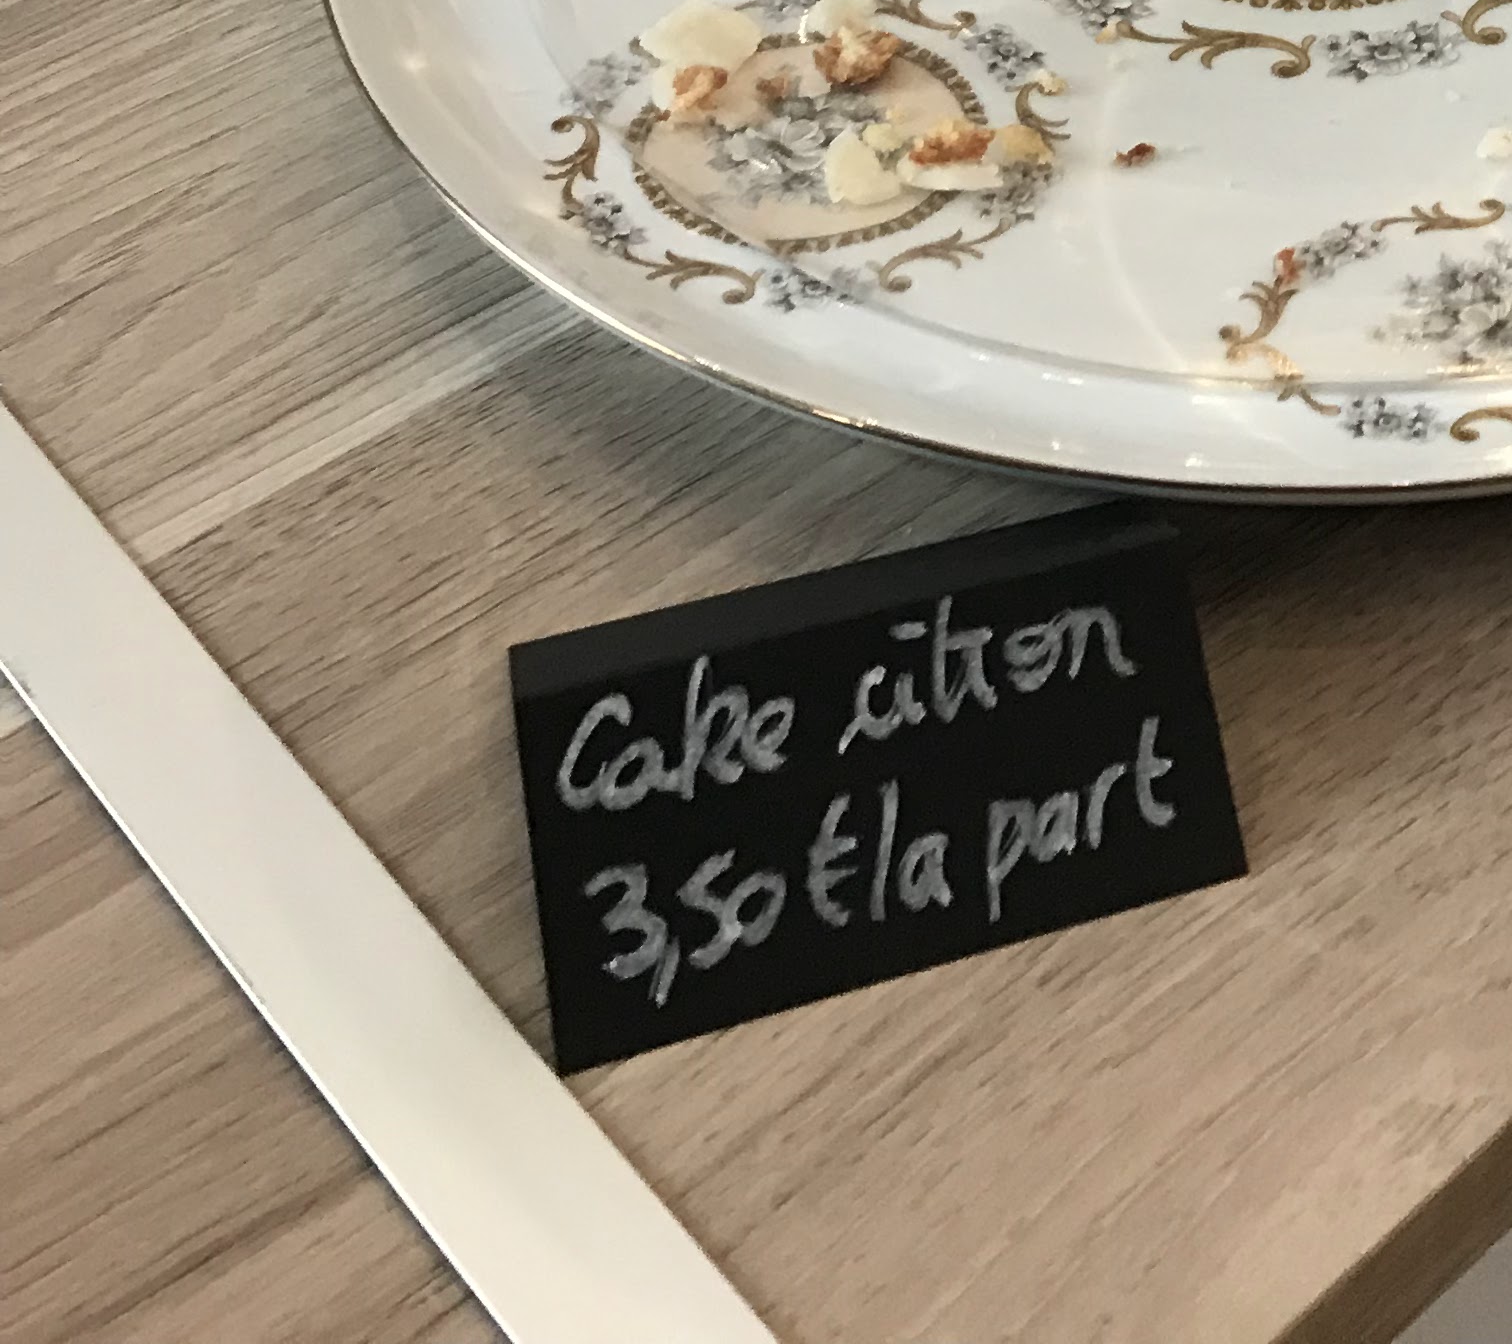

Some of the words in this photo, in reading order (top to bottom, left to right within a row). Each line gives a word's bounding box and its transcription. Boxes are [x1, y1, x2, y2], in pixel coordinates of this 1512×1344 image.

[556, 655, 795, 811] Cake
[836, 594, 1139, 755] citron
[582, 848, 788, 1009] 3,50
[985, 715, 1177, 925] part
